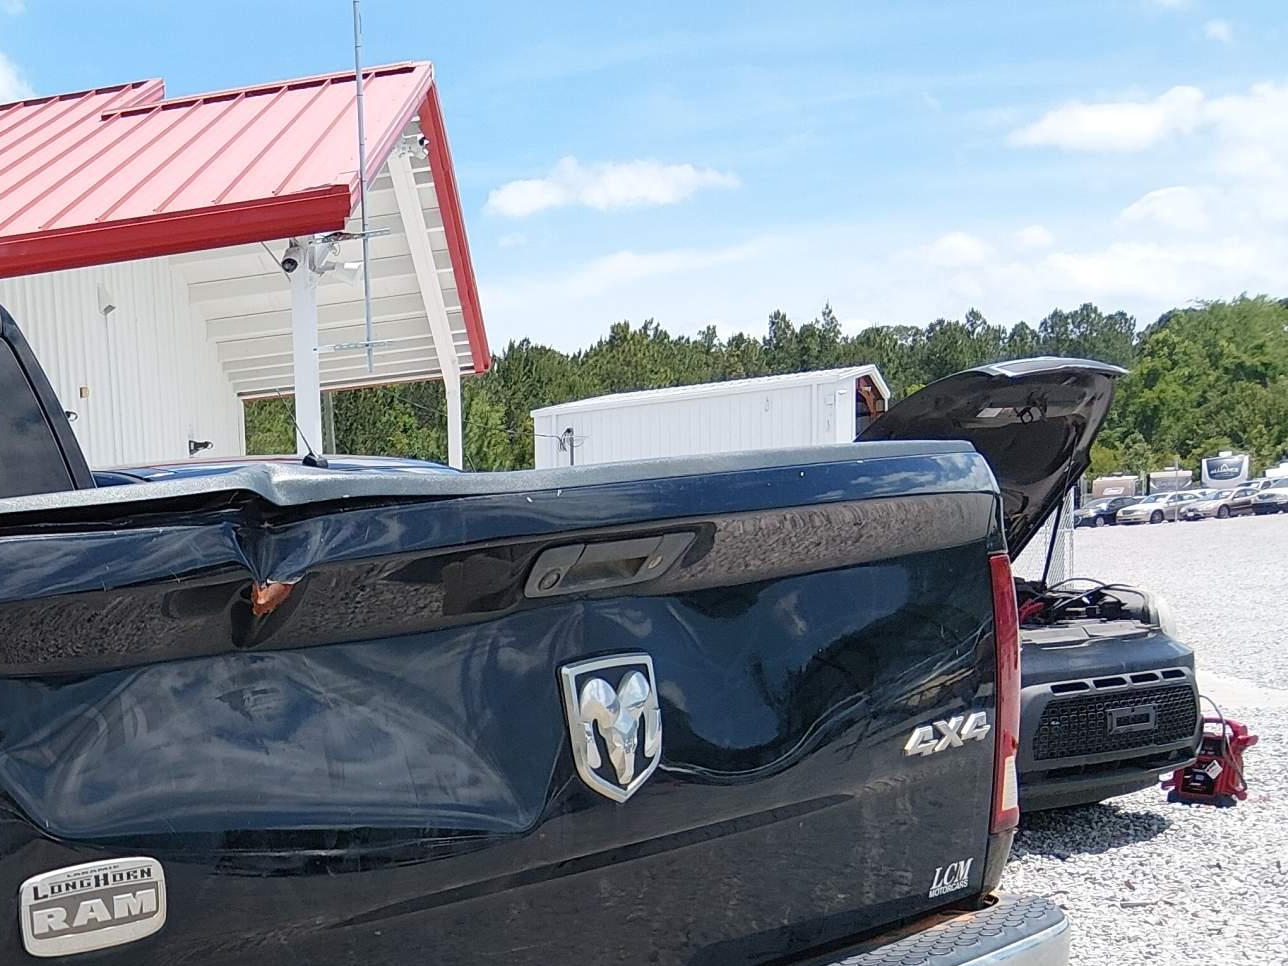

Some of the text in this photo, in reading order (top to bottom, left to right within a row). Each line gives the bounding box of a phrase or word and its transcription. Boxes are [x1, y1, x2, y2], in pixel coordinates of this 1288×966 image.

[928, 880, 969, 899] MOTORCARS
[930, 857, 974, 890] LCM
[32, 888, 157, 936] RAM
